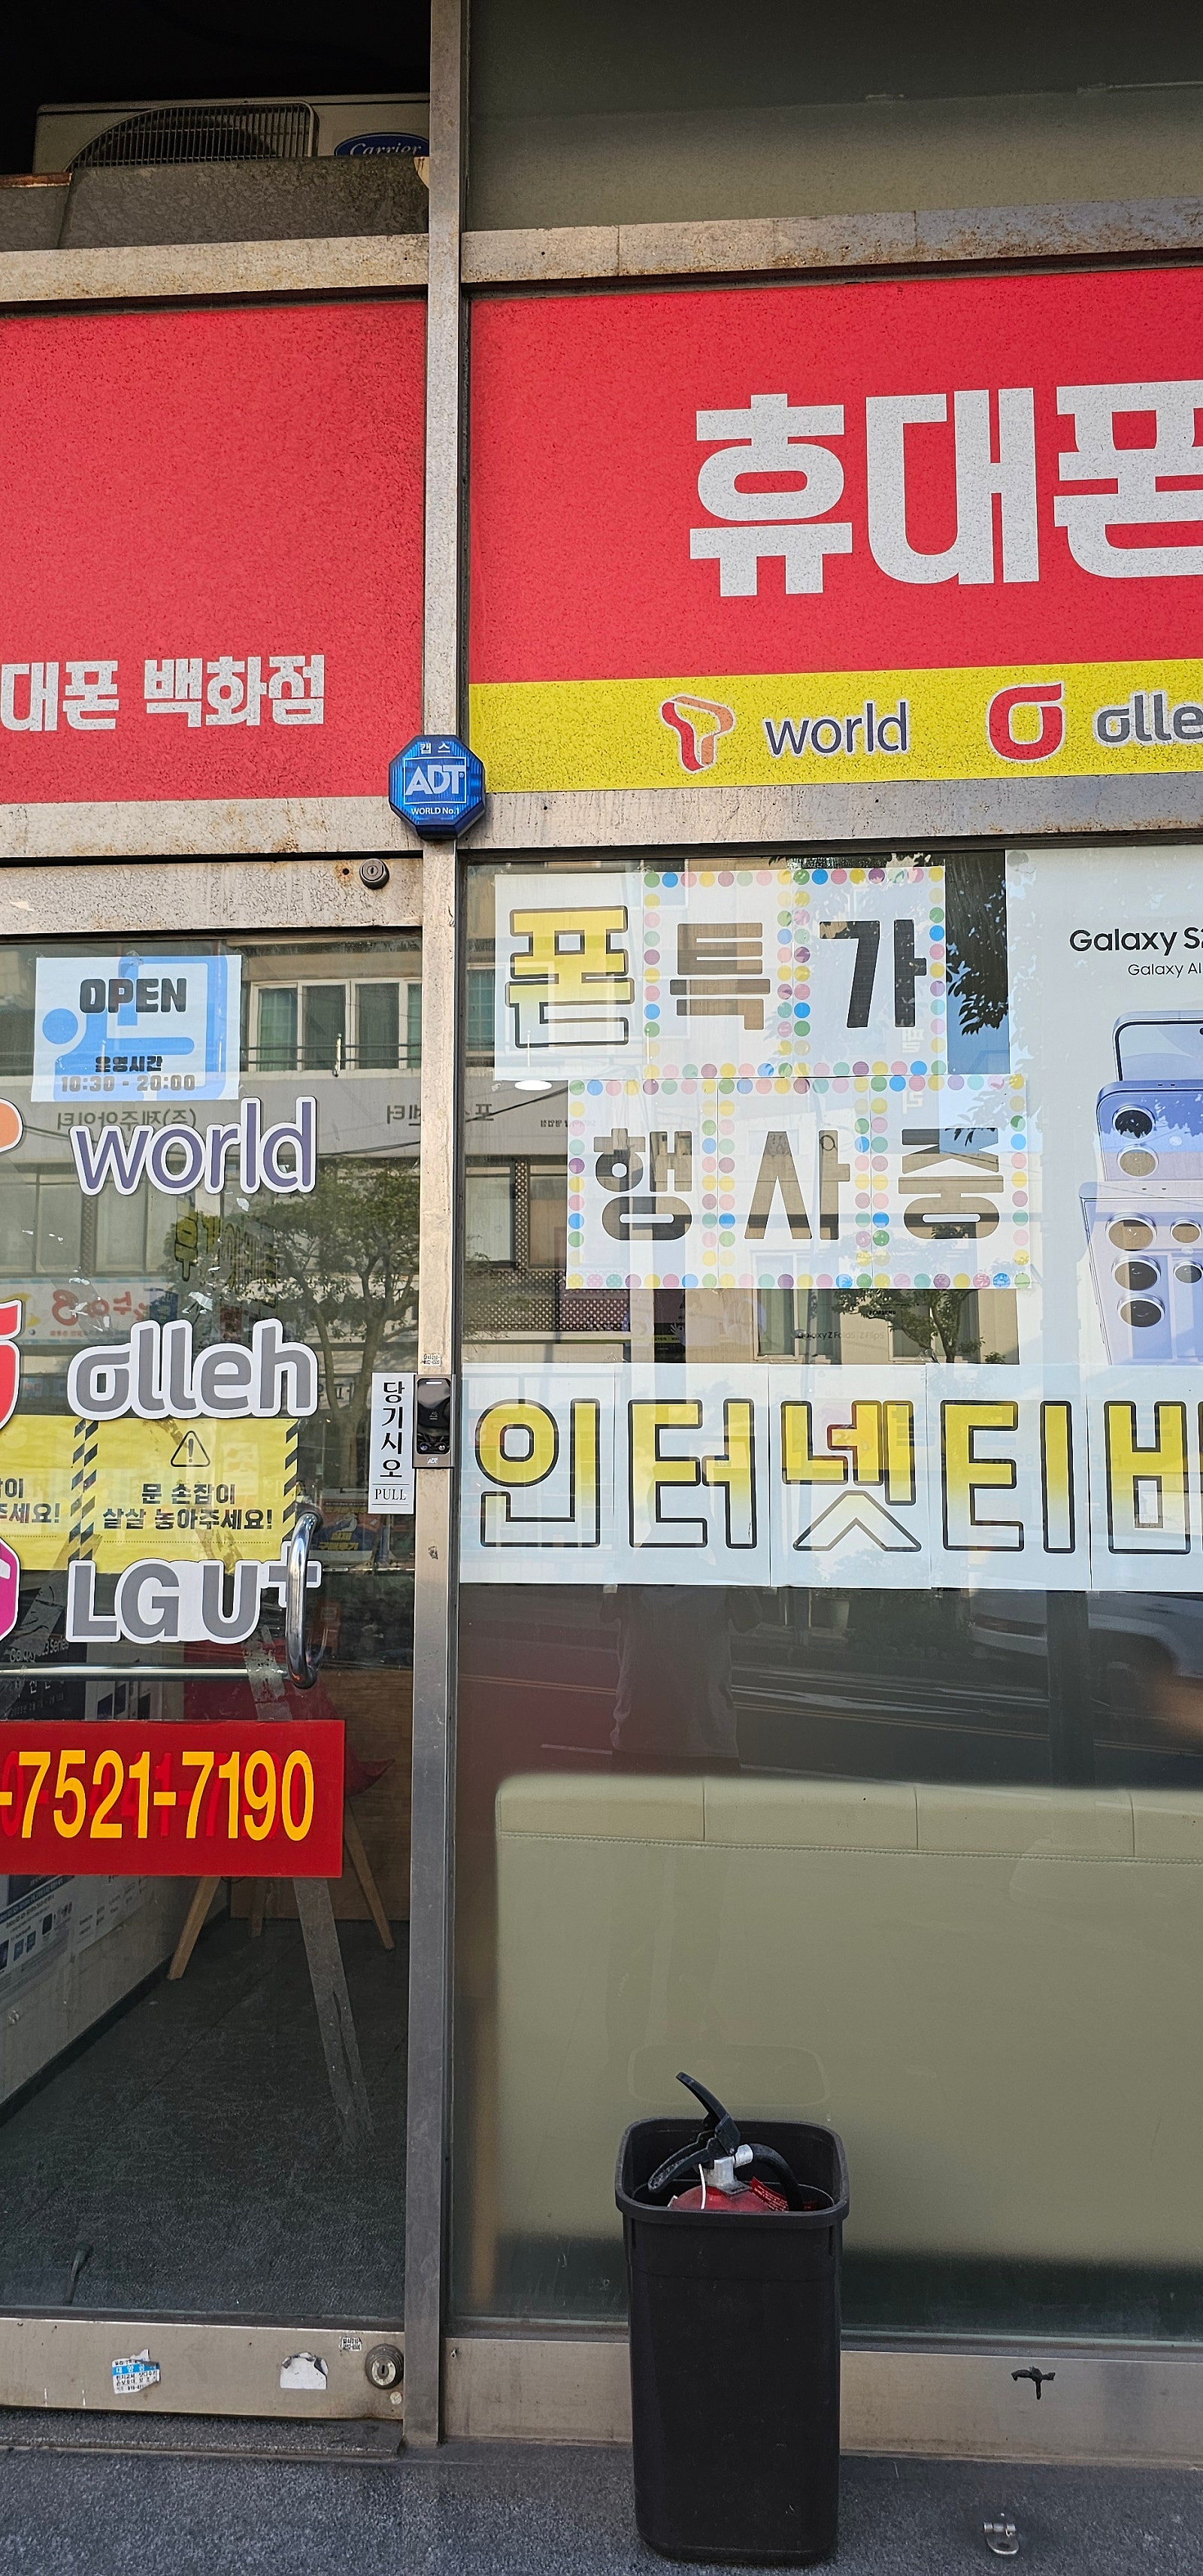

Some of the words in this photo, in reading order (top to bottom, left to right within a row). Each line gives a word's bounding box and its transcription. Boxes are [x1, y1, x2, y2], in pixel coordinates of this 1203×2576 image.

[350, 142, 421, 155] Carrier
[689, 380, 1203, 597] 휴대폰
[1, 660, 119, 732] 대폰
[144, 654, 325, 728] 백화점
[765, 702, 908, 754] world
[420, 743, 451, 754] 캡스
[405, 765, 467, 796] ADT
[1069, 928, 1177, 956] Galaxy
[1183, 926, 1203, 949] S
[1128, 962, 1183, 978] Galaxy
[1188, 962, 1201, 974] AI
[80, 978, 186, 1013] OPEN
[95, 1056, 163, 1072] 운영시간
[62, 1076, 115, 1092] 10:30
[137, 1074, 195, 1091] 20:00
[75, 1101, 313, 1194] world
[593, 1128, 1005, 1241] 행사중
[75, 1326, 312, 1412] olleh
[380, 1381, 405, 1478] 당기시오
[0, 1478, 24, 1499] 이
[142, 1483, 162, 1504] 문
[171, 1483, 235, 1505] 손잡이
[374, 1489, 407, 1500] PULL
[103, 1508, 146, 1529] 살살
[155, 1509, 272, 1530] 놓아주세요!
[73, 1565, 180, 1638] LG
[0, 1750, 314, 1841] -7521-7190
